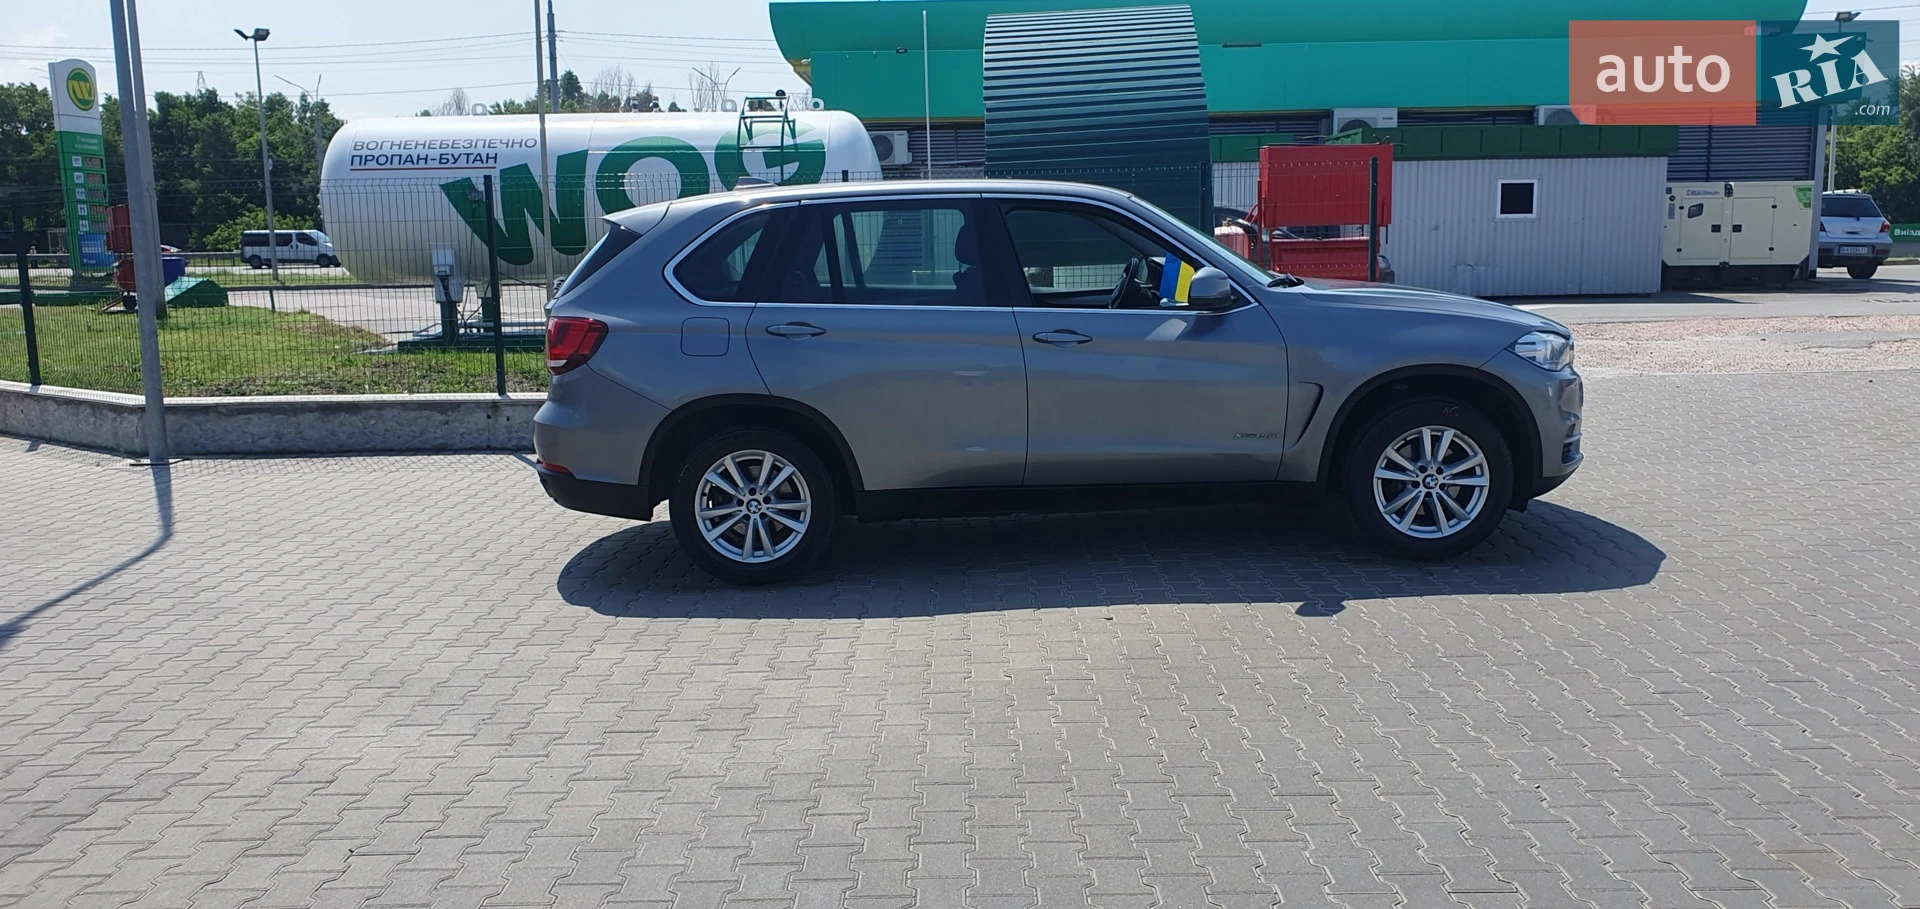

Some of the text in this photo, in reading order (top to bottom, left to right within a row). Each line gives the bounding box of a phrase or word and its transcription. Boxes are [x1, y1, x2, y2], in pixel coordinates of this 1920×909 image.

[353, 137, 538, 151] ВОГНЕНЕБЕЗПЕЧНО
[350, 152, 498, 167] ПРОПАН-БУТАН
[440, 120, 826, 265] WOG
